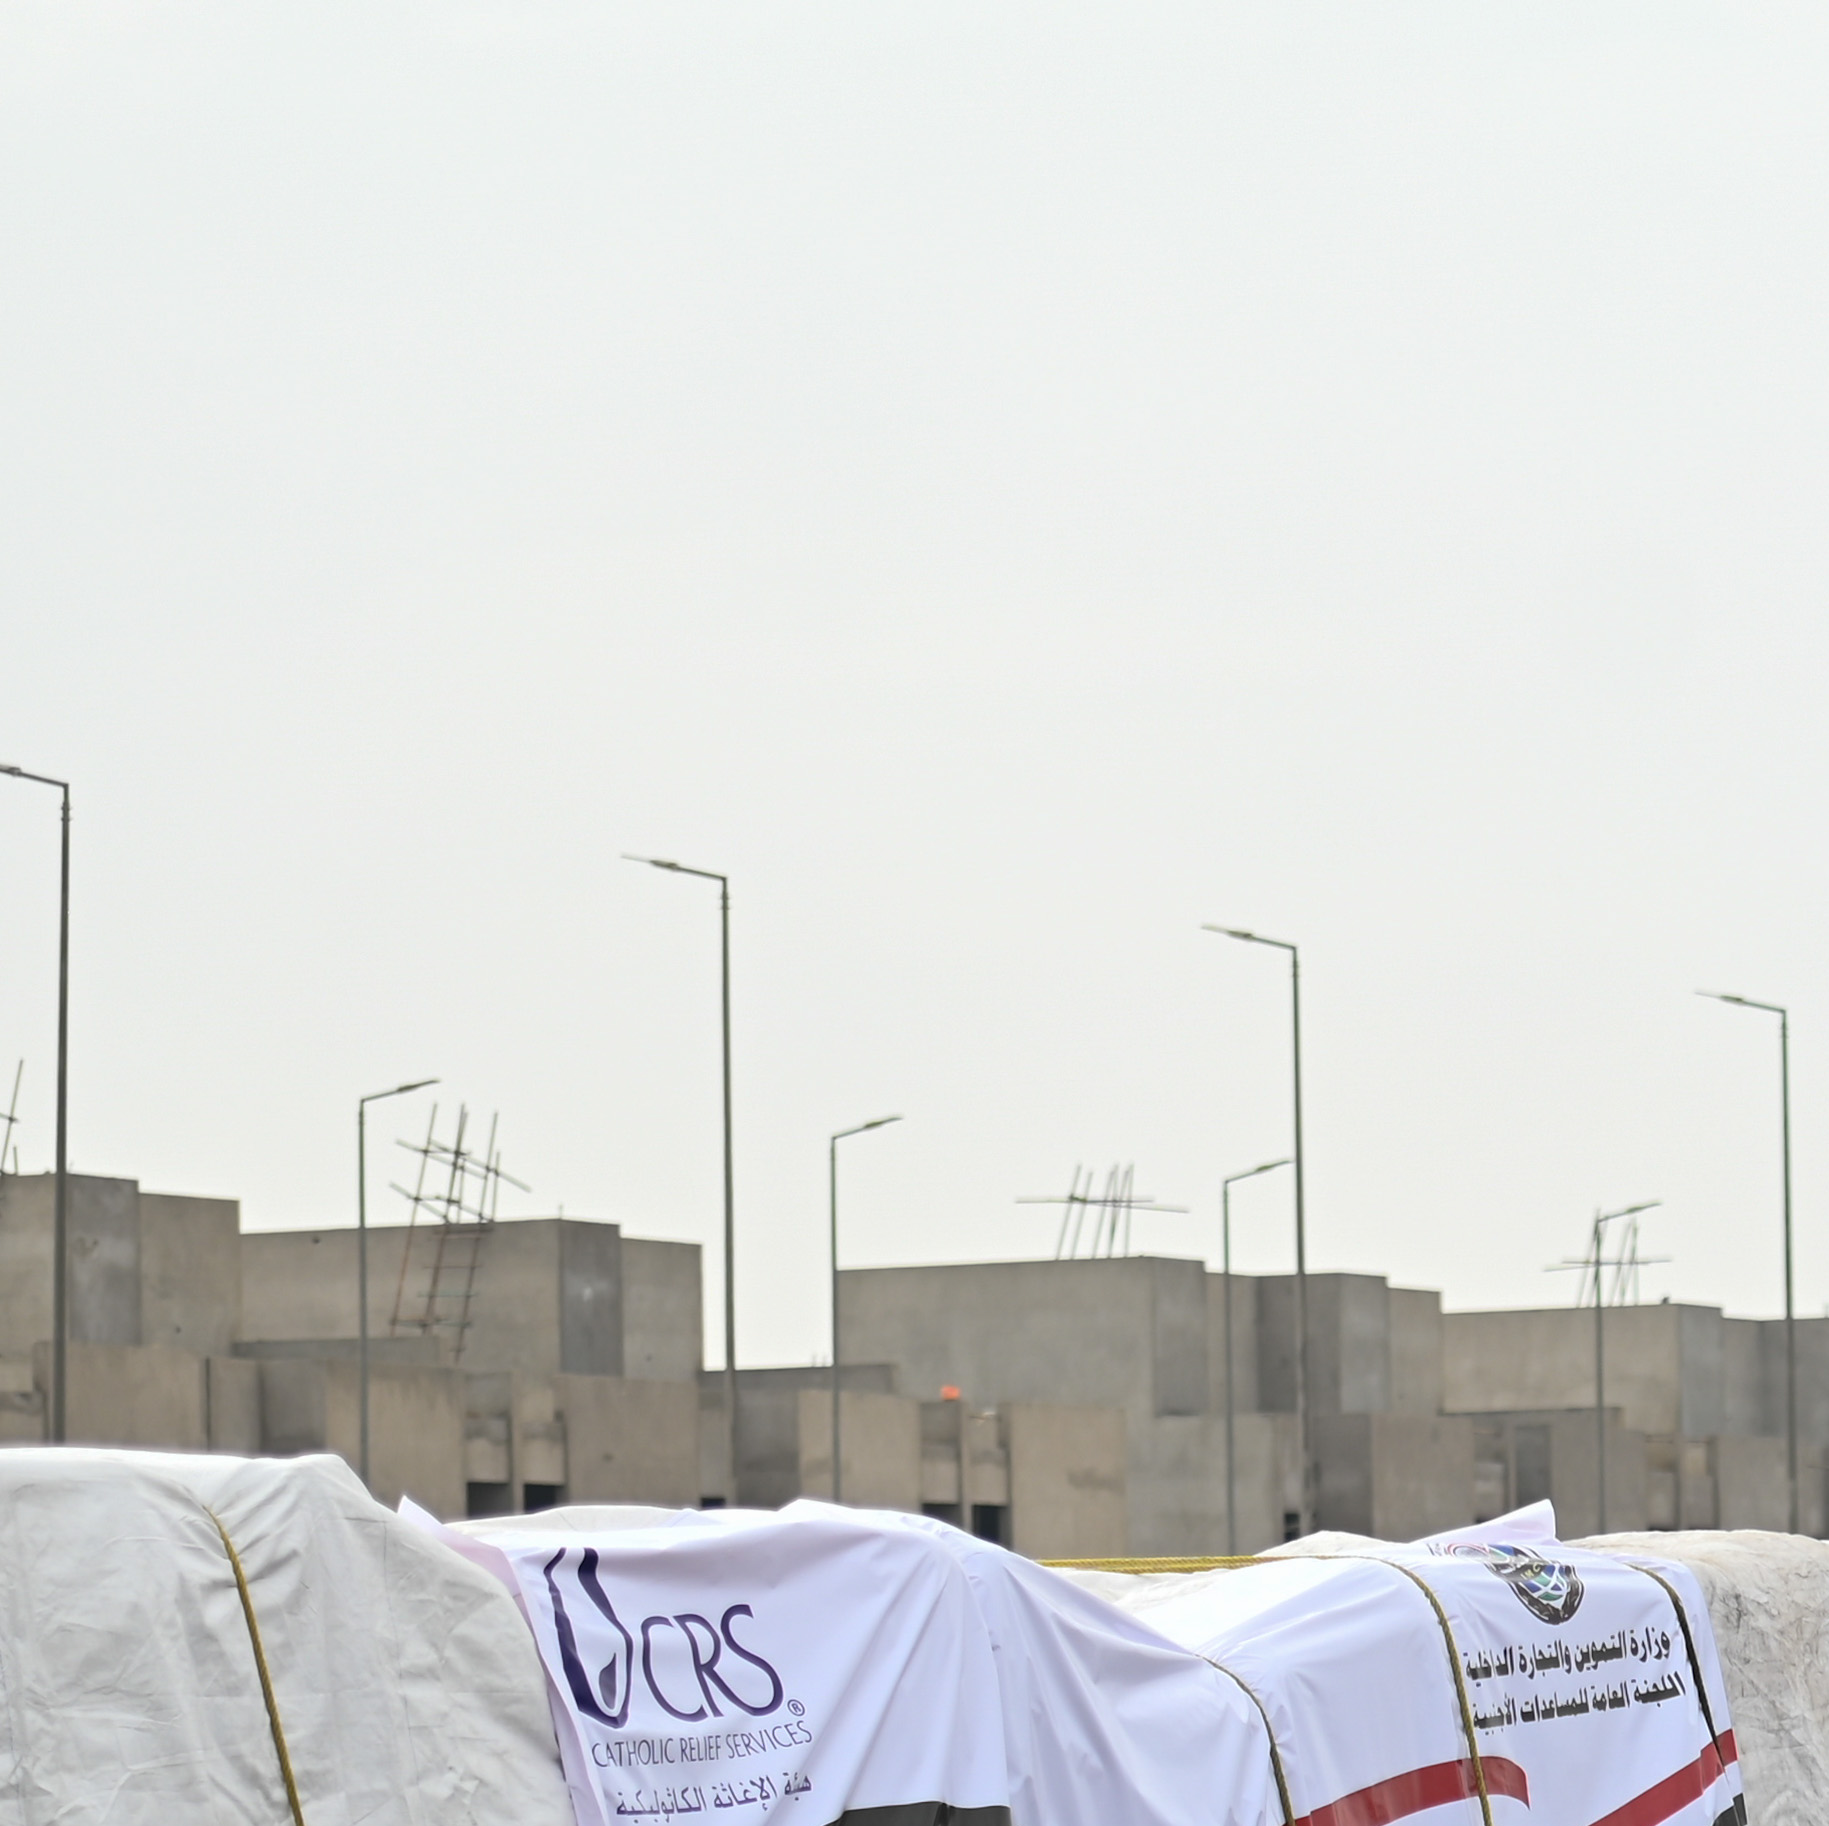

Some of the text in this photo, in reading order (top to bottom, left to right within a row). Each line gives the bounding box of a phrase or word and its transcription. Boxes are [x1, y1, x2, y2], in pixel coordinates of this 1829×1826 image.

[640, 1603, 784, 1722] CRS
[1462, 1626, 1671, 1688] وزارة التموين والتجارة الداخلية
[1520, 1687, 1590, 1725] للمساعدات
[1591, 1680, 1630, 1712] العامة
[1630, 1671, 1687, 1708] اللجنة
[591, 1720, 813, 1768] CATHOLIC RELIEF SERVICES
[713, 1774, 778, 1812] الإغاثة
